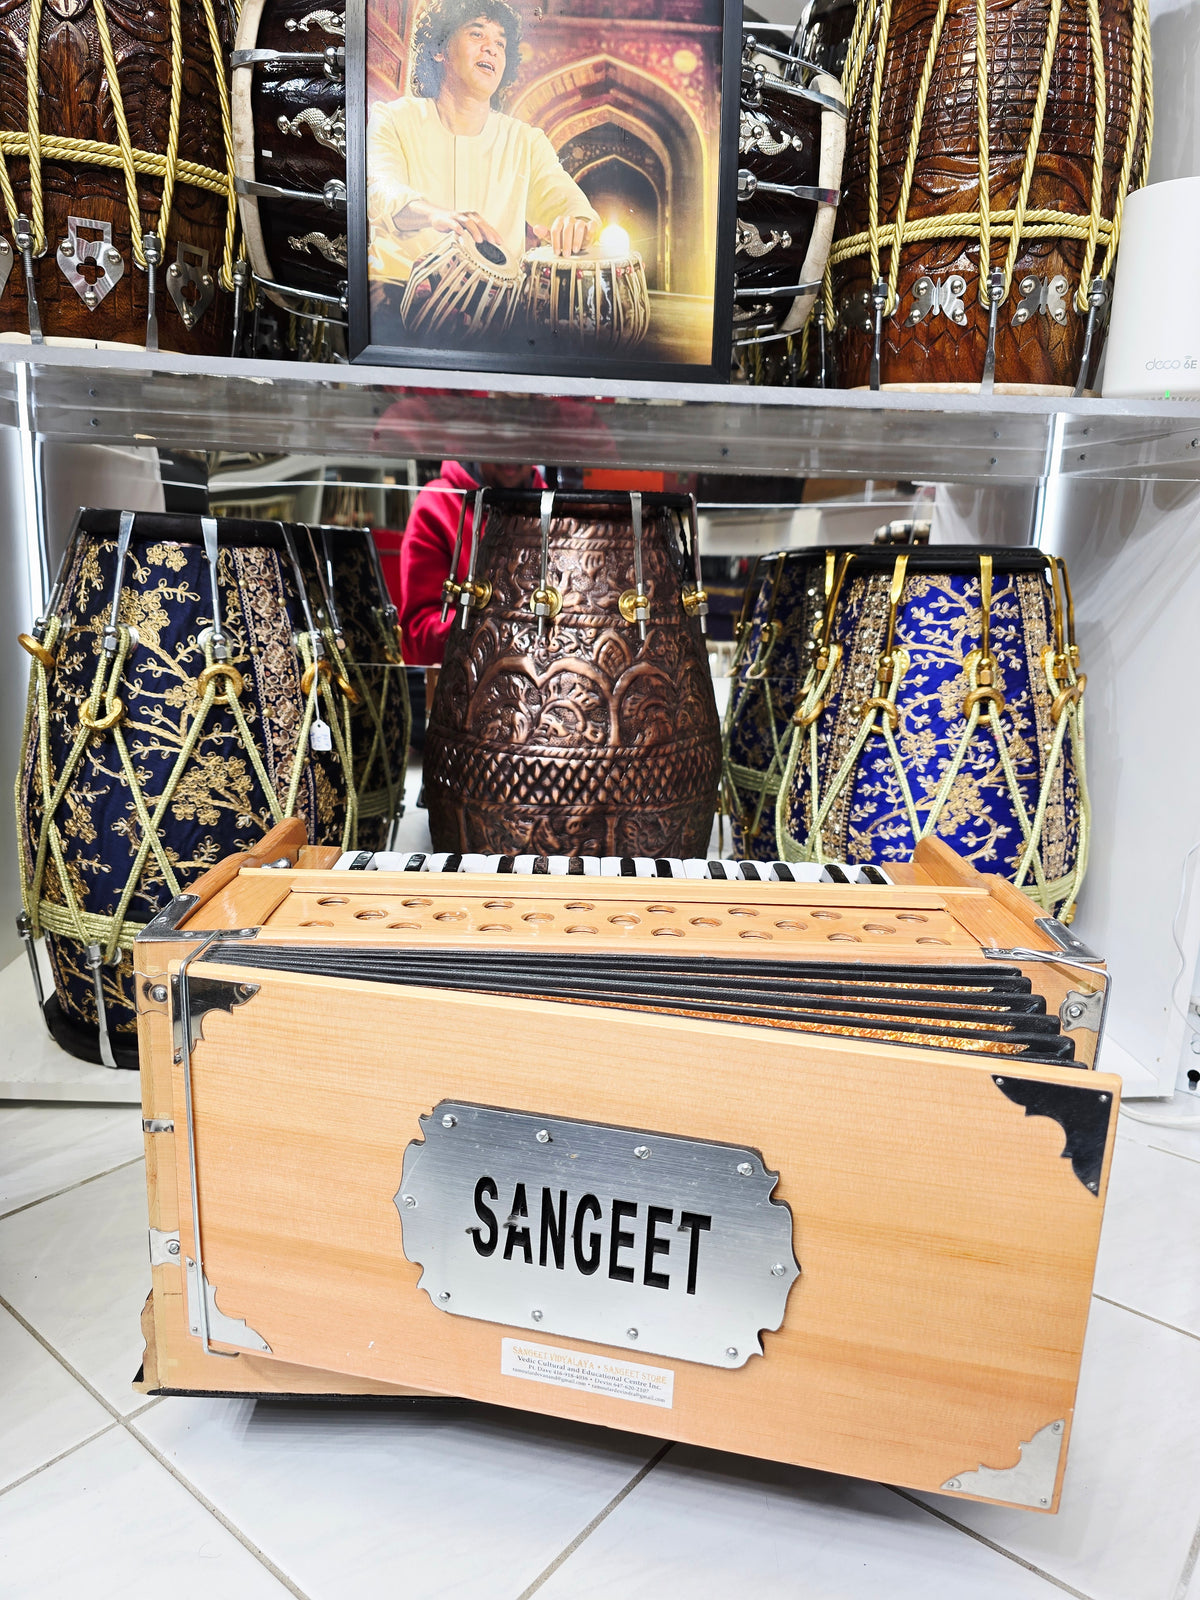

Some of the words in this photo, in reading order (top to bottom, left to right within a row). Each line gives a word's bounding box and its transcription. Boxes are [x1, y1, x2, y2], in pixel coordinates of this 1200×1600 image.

[1145, 358, 1180, 370] deco
[1183, 360, 1197, 369] 6E
[467, 1175, 712, 1296] SANGEET
[512, 1345, 547, 1359] SANGEET
[549, 1352, 594, 1369] VIDYALAYA
[603, 1364, 640, 1378] SANGEET
[641, 1371, 667, 1384] STORE
[517, 1355, 535, 1363] Vedic
[537, 1359, 565, 1370] Cultural
[581, 1368, 622, 1381] Educational
[623, 1377, 647, 1386] Centre
